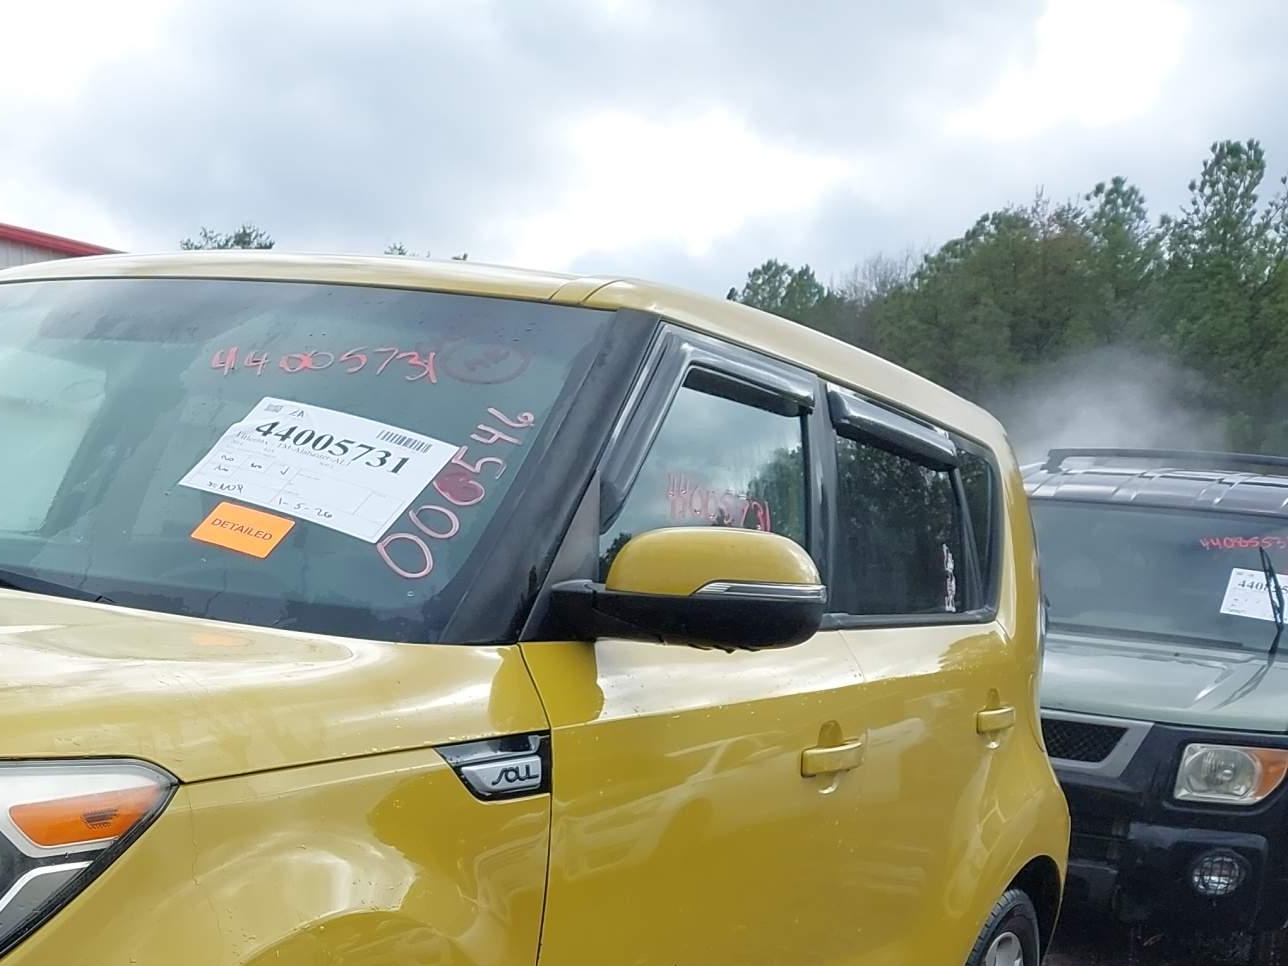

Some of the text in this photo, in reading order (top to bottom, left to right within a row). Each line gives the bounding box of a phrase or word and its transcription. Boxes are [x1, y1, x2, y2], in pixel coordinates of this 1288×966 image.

[212, 346, 438, 384] 44005731
[255, 420, 410, 475] 44005731
[211, 518, 273, 541] DETAILED
